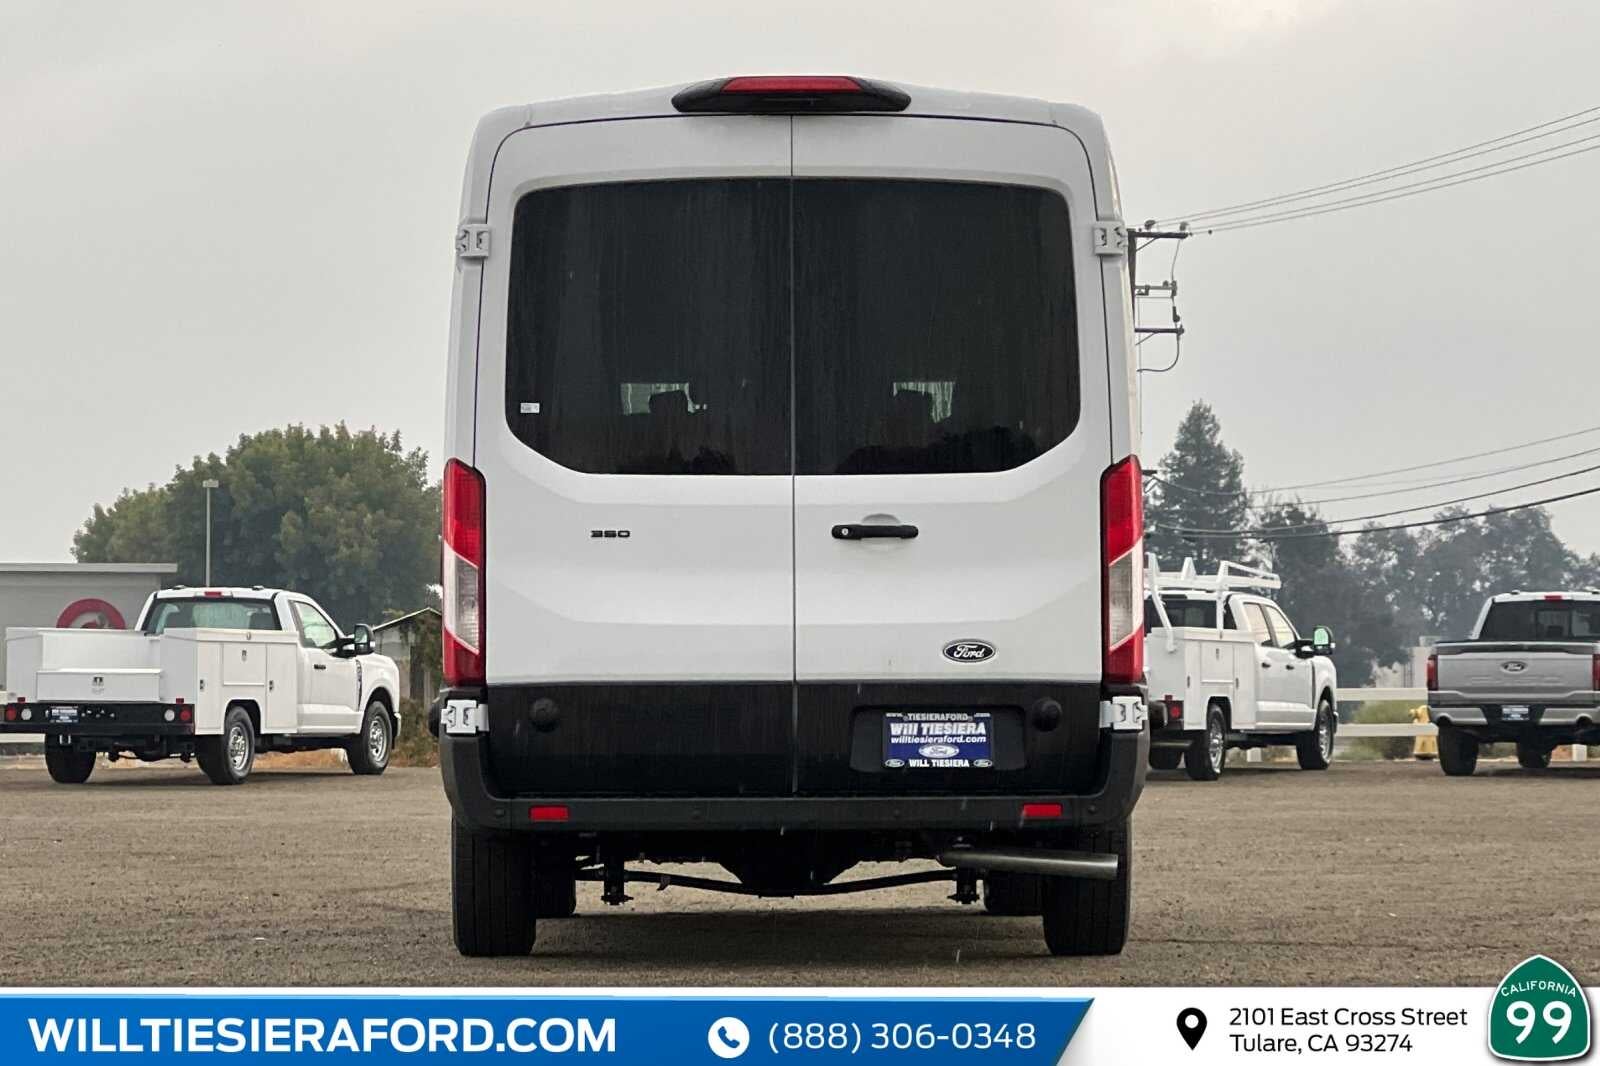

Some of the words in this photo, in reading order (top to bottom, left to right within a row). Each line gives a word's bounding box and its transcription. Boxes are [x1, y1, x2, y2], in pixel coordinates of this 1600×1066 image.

[953, 644, 985, 658] Ford
[921, 722, 986, 735] TIESIERA
[909, 759, 930, 767] WILL
[931, 759, 970, 767] TIESIERA
